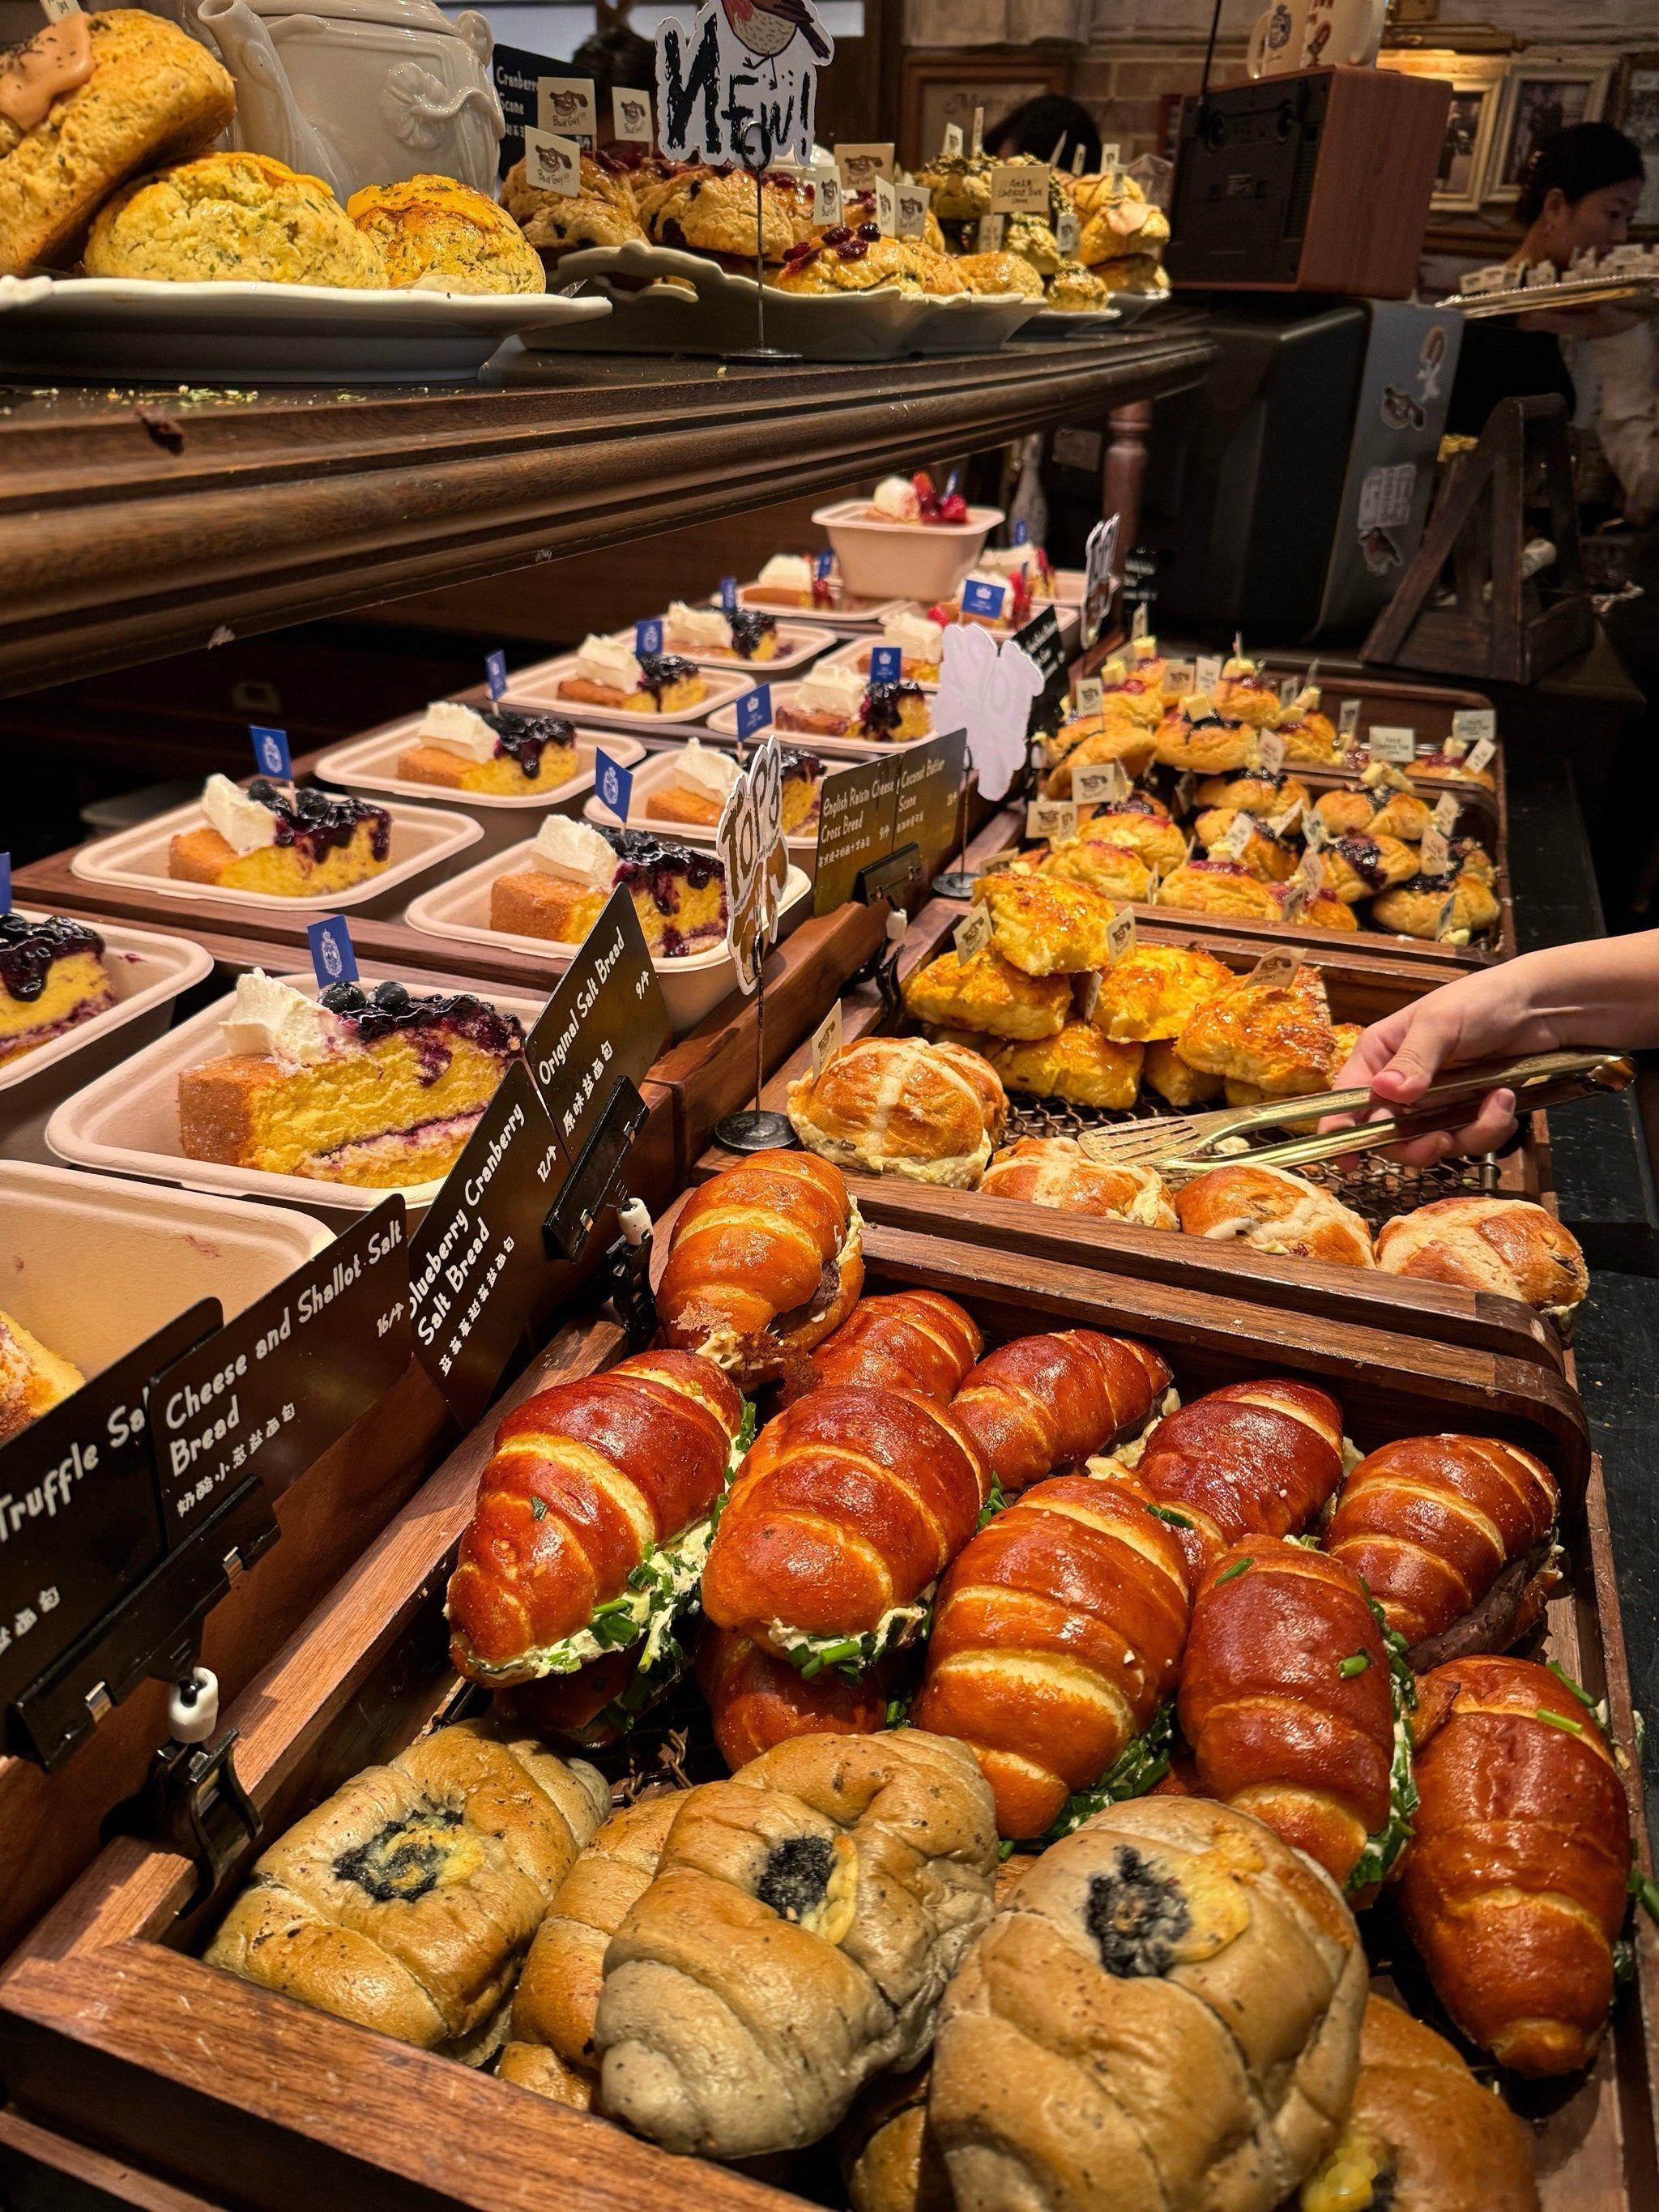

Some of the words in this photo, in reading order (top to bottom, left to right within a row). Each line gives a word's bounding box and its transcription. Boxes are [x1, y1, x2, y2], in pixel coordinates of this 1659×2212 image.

[821, 824, 842, 844] Cross
[842, 810, 864, 835] Bread
[822, 791, 848, 819] English
[850, 786, 870, 809] Raisin
[871, 779, 894, 800] Cheese
[539, 1009, 580, 1085] Original
[577, 977, 599, 1018] Salt
[595, 925, 625, 985] Bread
[635, 970, 650, 1000] 9/个
[563, 1040, 613, 1138] 原味盐面包
[465, 1103, 525, 1206] Cranberry
[166, 1354, 248, 1429] Cheese
[255, 1306, 291, 1360] and
[297, 1253, 362, 1324] Shallot
[368, 1219, 403, 1265] Salt
[376, 1301, 404, 1338] 16/个
[418, 1292, 451, 1346] Salt
[446, 1216, 490, 1294] Bread
[169, 1394, 240, 1478] Bread
[177, 1402, 296, 1518] 奶酪小葱盐面包
[0, 1441, 100, 1543] Truffle
